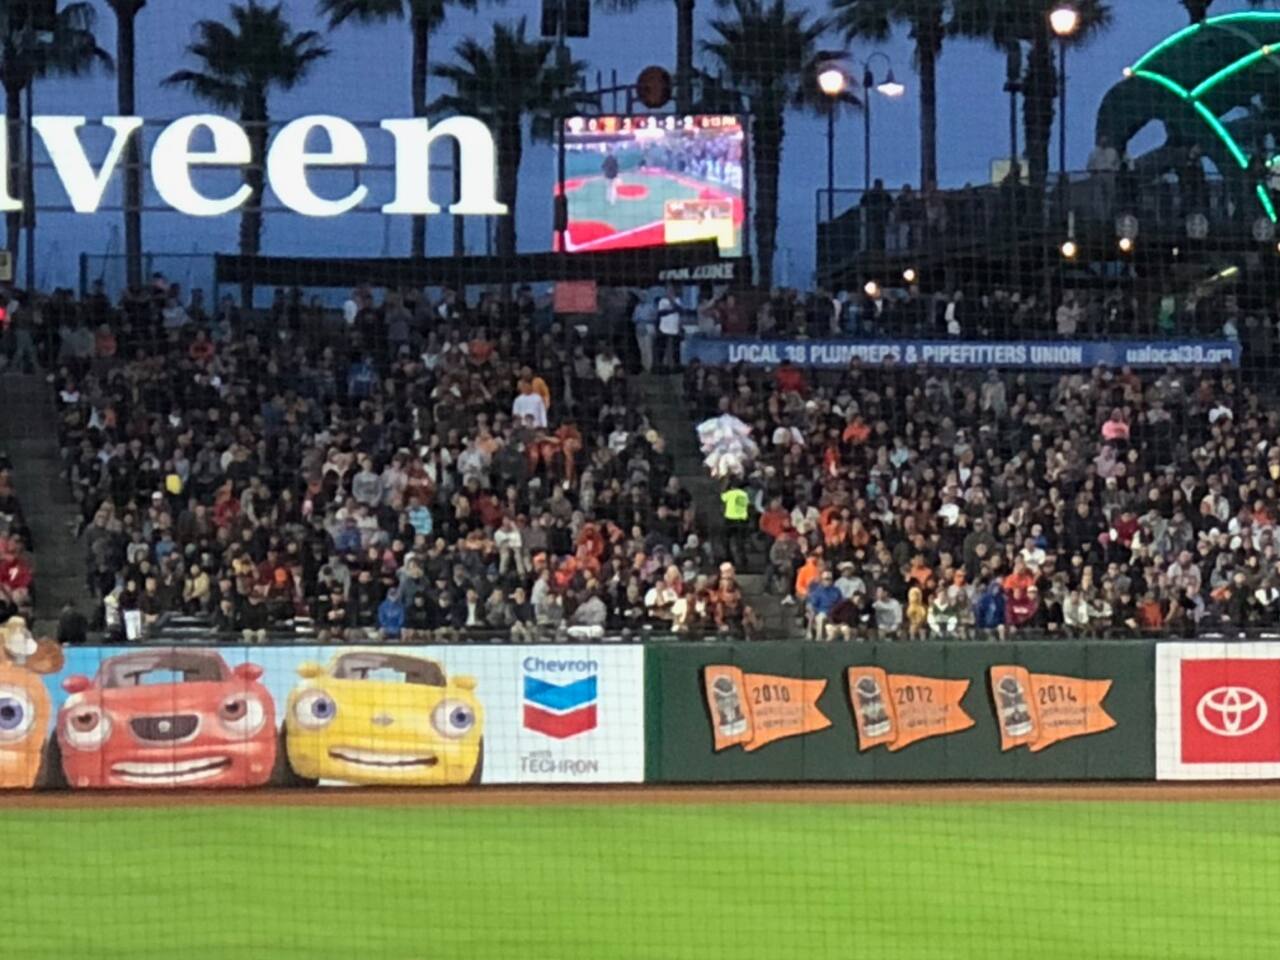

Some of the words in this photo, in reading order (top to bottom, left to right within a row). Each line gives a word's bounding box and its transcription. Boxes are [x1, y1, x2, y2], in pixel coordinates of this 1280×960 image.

[728, 344, 781, 363] LOCAL
[905, 345, 918, 363] &
[922, 345, 1027, 364] PIPEFITTERS
[1030, 346, 1083, 364] UNION
[523, 656, 598, 672] Chevron
[752, 684, 791, 705] 2010
[896, 685, 933, 705] 2012
[1038, 685, 1077, 705] 2014
